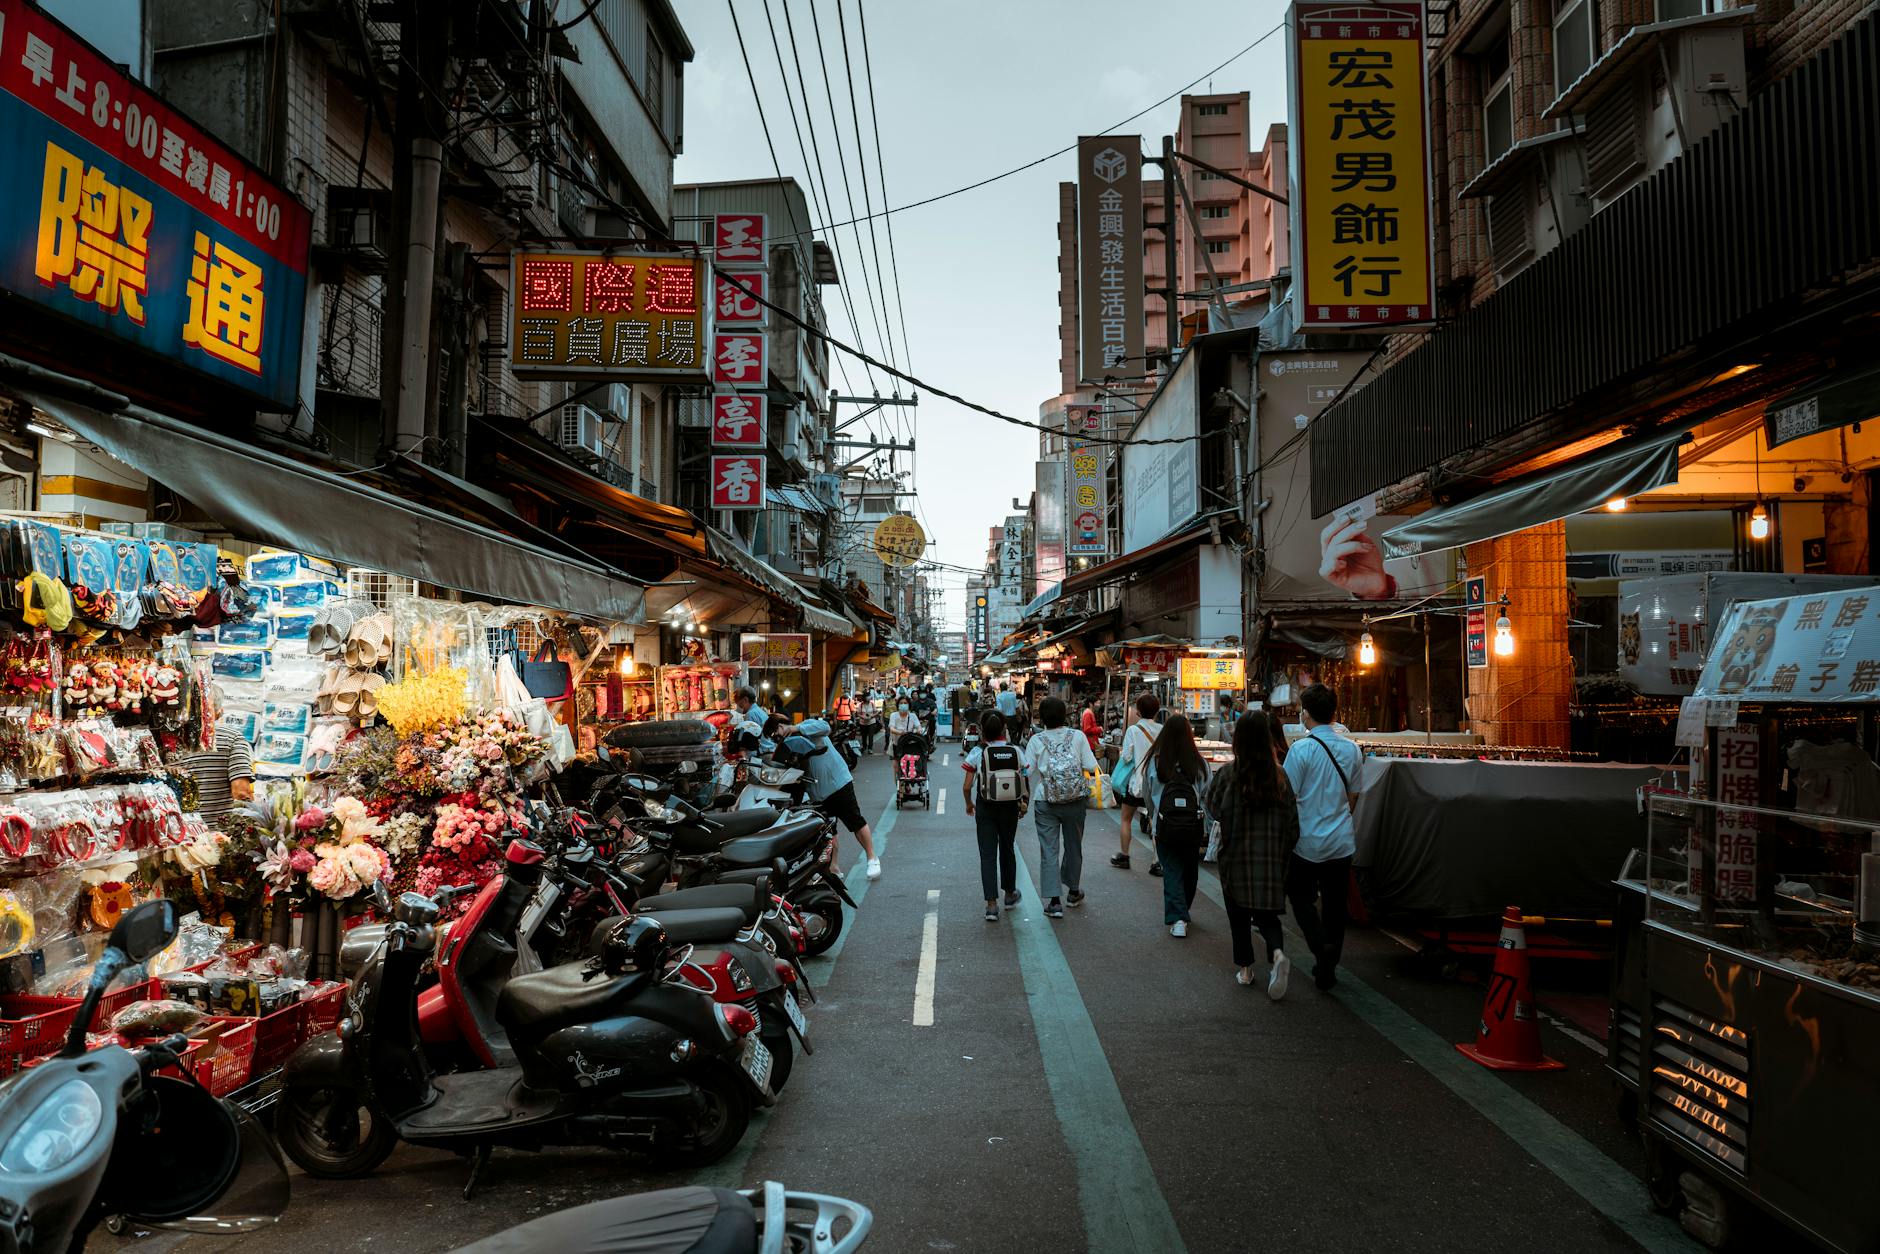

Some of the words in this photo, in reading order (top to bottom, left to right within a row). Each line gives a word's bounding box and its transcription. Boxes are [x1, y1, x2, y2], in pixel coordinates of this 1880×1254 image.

[1310, 25, 1410, 38] 重新市場
[21, 32, 280, 240] 早上8:00至凌晨1:00
[1328, 48, 1402, 297] 宏茂男飾行
[35, 141, 265, 374] 際通
[523, 262, 696, 313] 國際通
[1099, 188, 1126, 369] 金興發生活百貨
[521, 317, 696, 365] 百貨廣場
[1318, 307, 1419, 319] 重新市場
[716, 218, 762, 502] 玉記李亭香
[1720, 738, 1759, 805] 招牌
[1716, 833, 1756, 900] 脆腸
